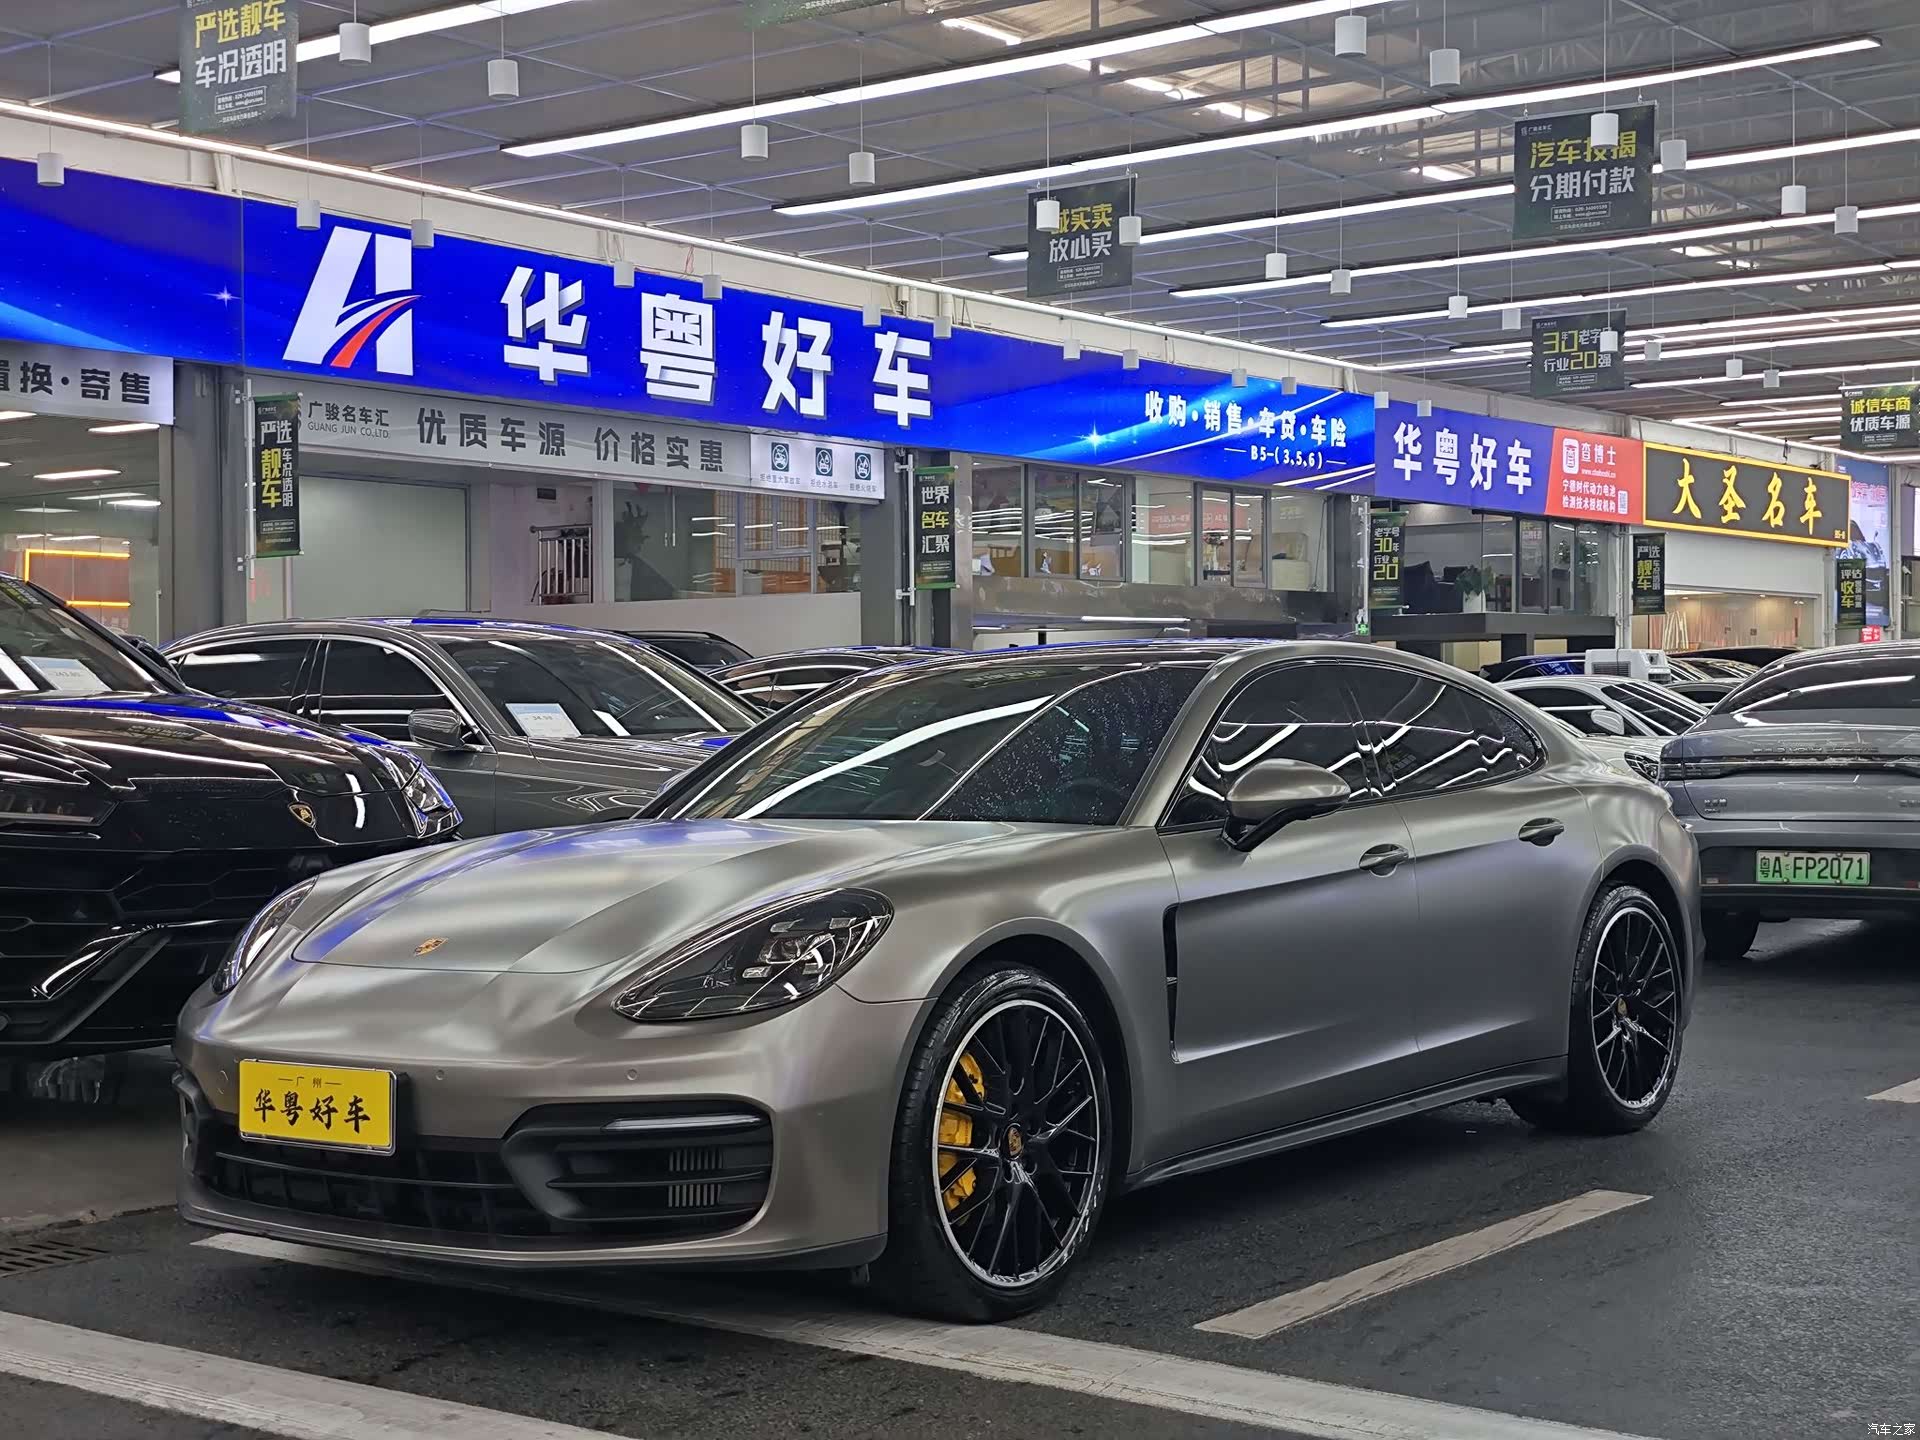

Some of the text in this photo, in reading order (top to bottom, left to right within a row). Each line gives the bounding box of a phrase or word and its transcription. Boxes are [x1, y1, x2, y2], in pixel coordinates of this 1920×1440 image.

[195, 0, 286, 48] 严选靓车
[195, 39, 286, 88] 车况透明
[1529, 165, 1635, 202] 分期付款
[1049, 231, 1112, 263] 放心买
[500, 265, 933, 427] 华粤好车
[1544, 350, 1612, 372] 行业20强
[308, 400, 389, 427] 广骏名车汇
[1850, 396, 1911, 415] 诚信车商
[260, 420, 293, 445] 严选
[308, 421, 338, 433] GUANG
[341, 424, 357, 435] JUN
[1850, 414, 1911, 432] 优质车源
[417, 407, 724, 473] 优质车源 价格实惠
[1392, 421, 1532, 495] 华粤好车
[1581, 442, 1616, 466] 查博士
[261, 448, 282, 508] 靓车
[1562, 479, 1616, 497] 宁德时代动力电池
[921, 485, 949, 505] 世界
[1672, 457, 1822, 536] 大圣名车
[921, 510, 949, 529] 名车
[1374, 526, 1400, 537] 老字号
[921, 534, 949, 554] 汇聚
[1637, 545, 1660, 558] 严选
[1374, 555, 1390, 564] 行业
[1373, 563, 1399, 580] 20
[1841, 569, 1862, 579] 评估
[1841, 580, 1855, 608] 收车
[296, 1076, 323, 1089] 广州
[253, 1088, 371, 1134] 华粤好车
